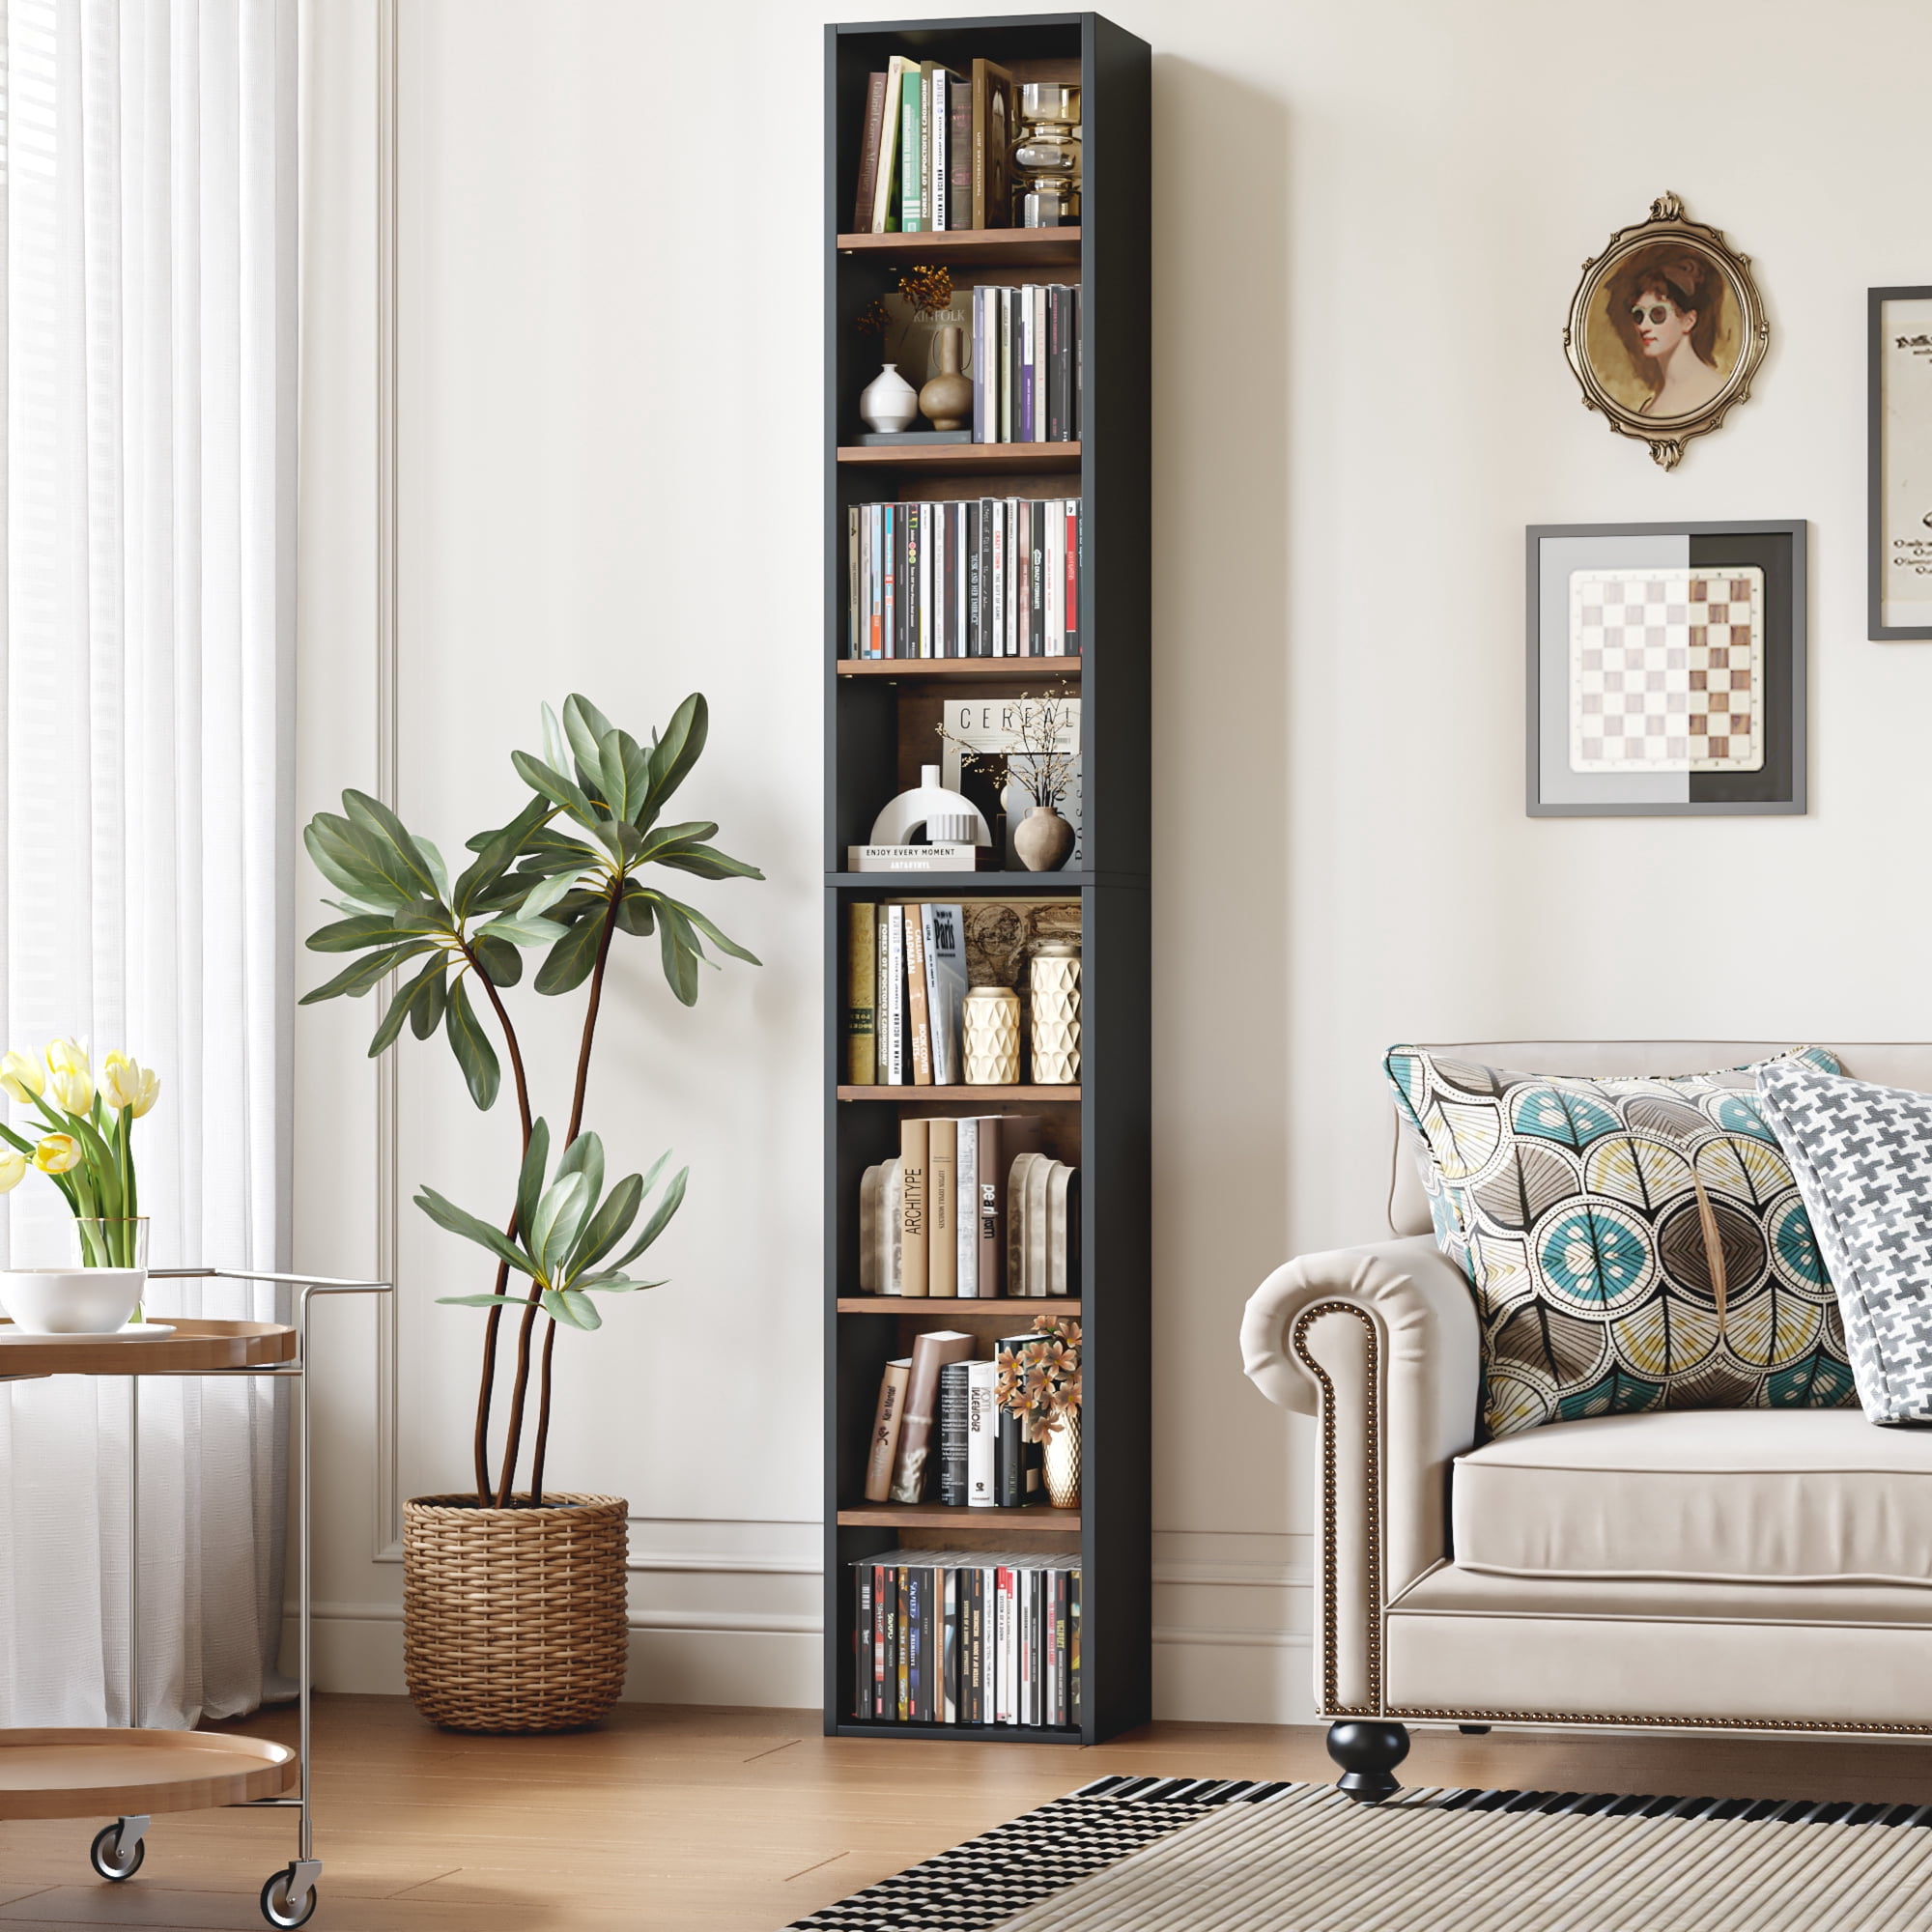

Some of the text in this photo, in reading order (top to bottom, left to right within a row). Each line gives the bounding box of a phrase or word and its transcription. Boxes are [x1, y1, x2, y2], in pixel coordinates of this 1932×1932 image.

[870, 81, 883, 115] Gabriel
[959, 707, 1074, 729] CEREAL
[905, 919, 916, 974] CHAPMAN
[934, 919, 955, 950] Paris
[920, 1047, 928, 1074] COVER
[904, 1168, 922, 1236] ARCHITYPE
[980, 1184, 998, 1214] pearl
